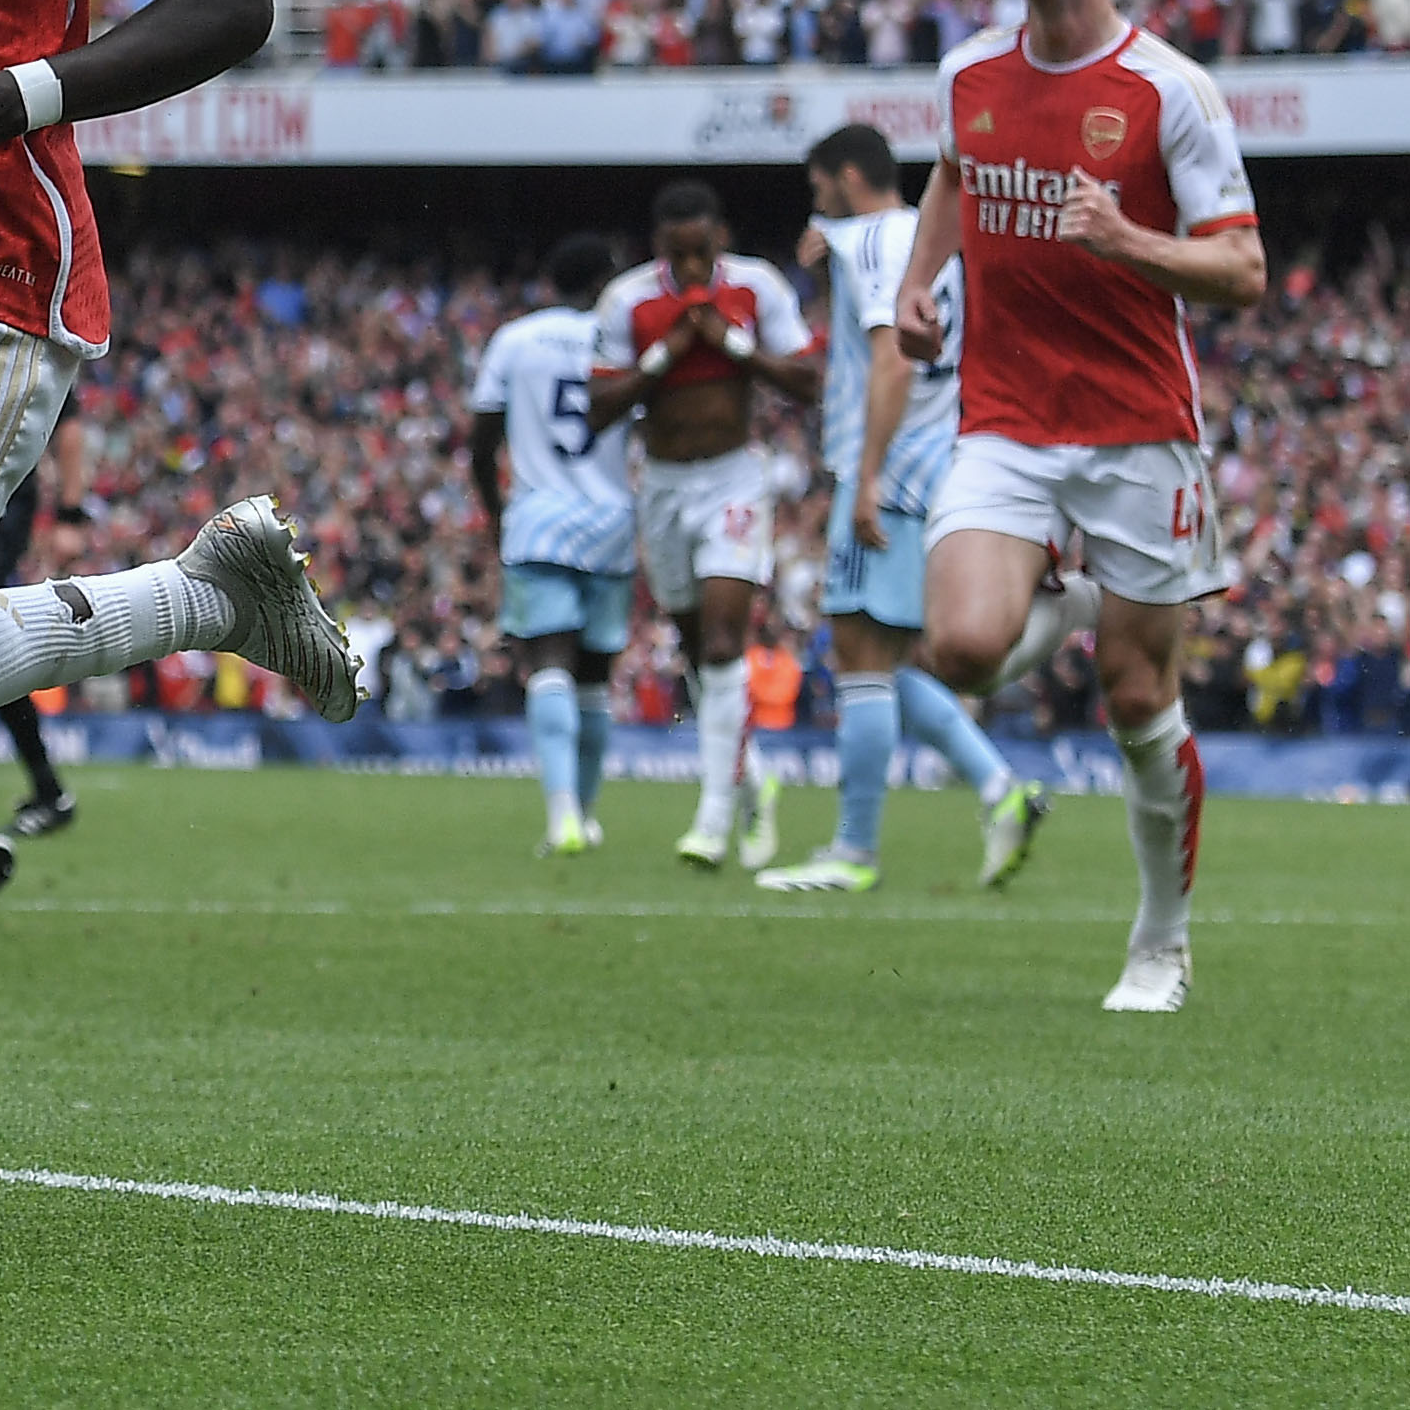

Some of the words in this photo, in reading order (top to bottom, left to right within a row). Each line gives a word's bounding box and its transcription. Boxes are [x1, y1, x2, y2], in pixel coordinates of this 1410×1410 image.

[979, 200, 1012, 235] FLY
[1015, 203, 1061, 242] BET
[554, 379, 596, 457] 5
[1172, 482, 1204, 541] 41
